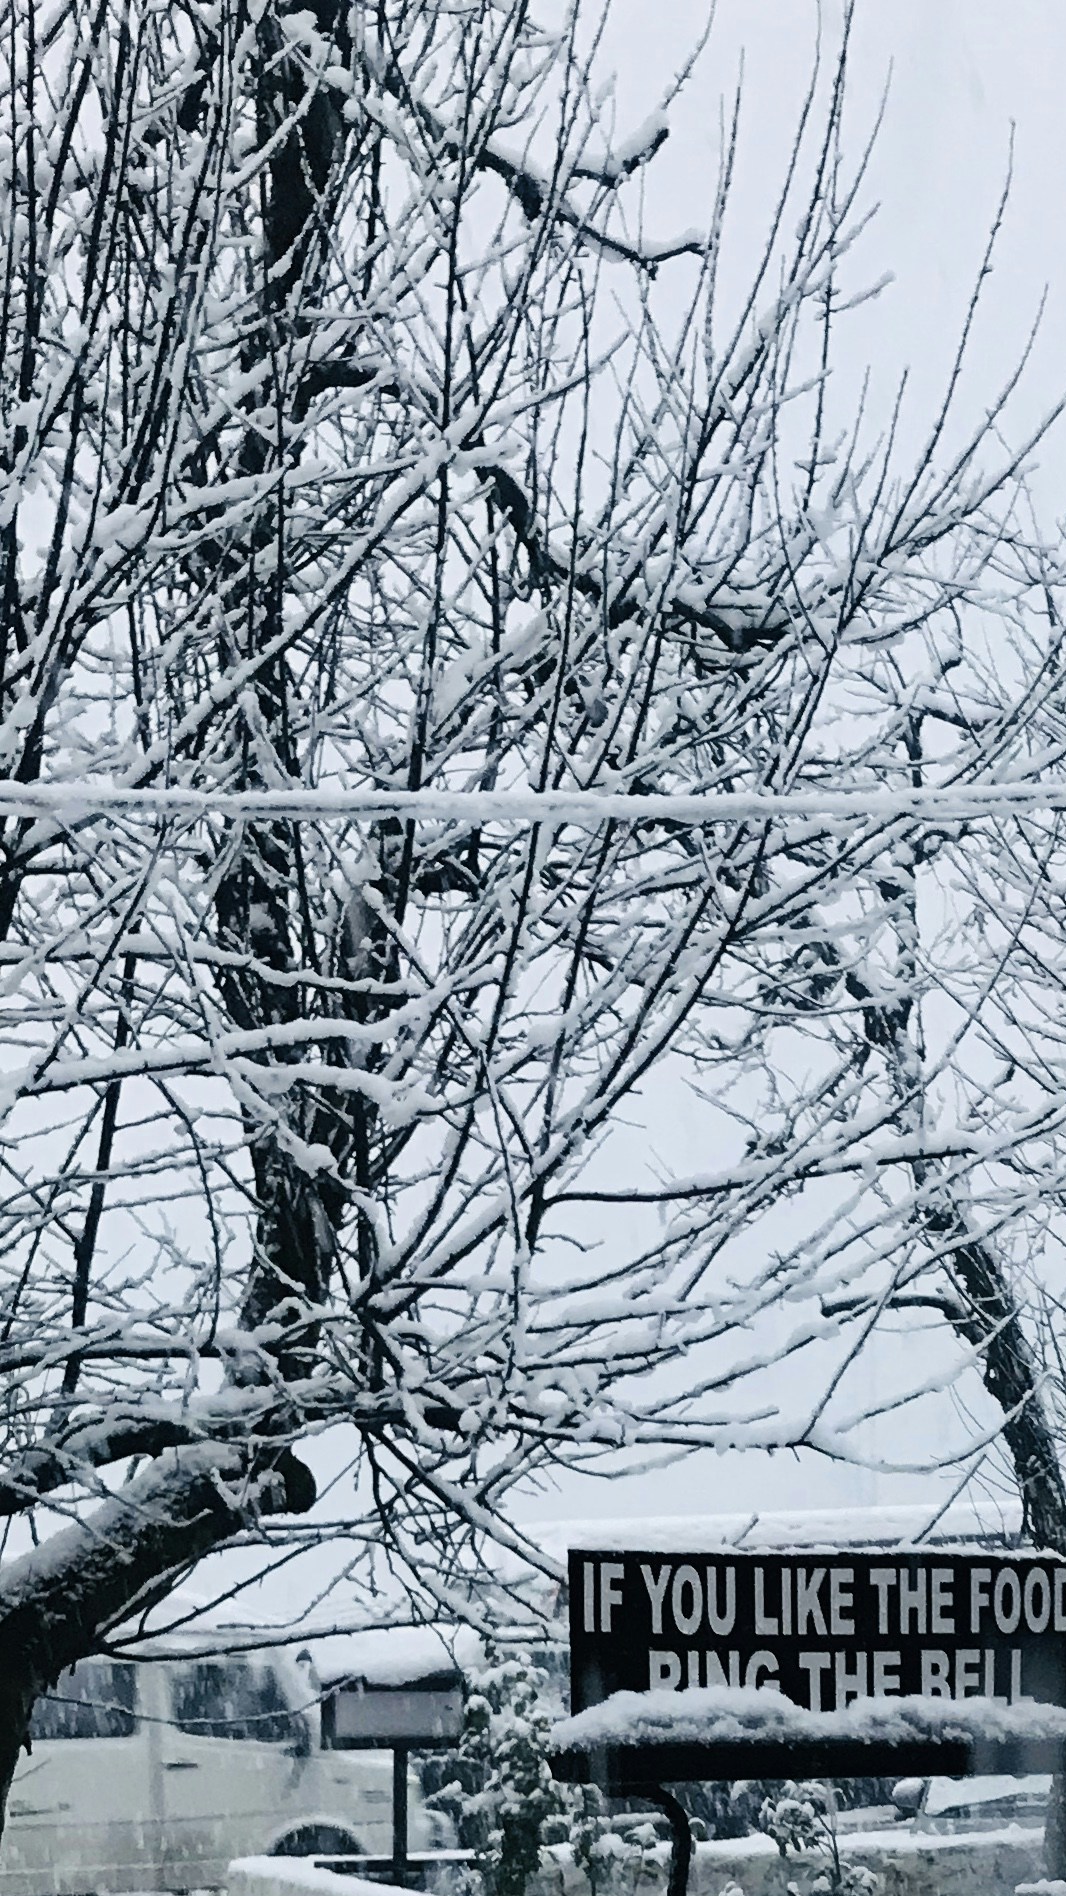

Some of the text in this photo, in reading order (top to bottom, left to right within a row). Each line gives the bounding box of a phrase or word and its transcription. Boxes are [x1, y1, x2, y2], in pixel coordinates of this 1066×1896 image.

[583, 1562, 625, 1633] IF
[640, 1564, 736, 1635] YOU
[755, 1566, 856, 1636] LIKE
[869, 1567, 956, 1635] THE
[799, 1651, 901, 1712] THE
[921, 1649, 1034, 1704] BELL
